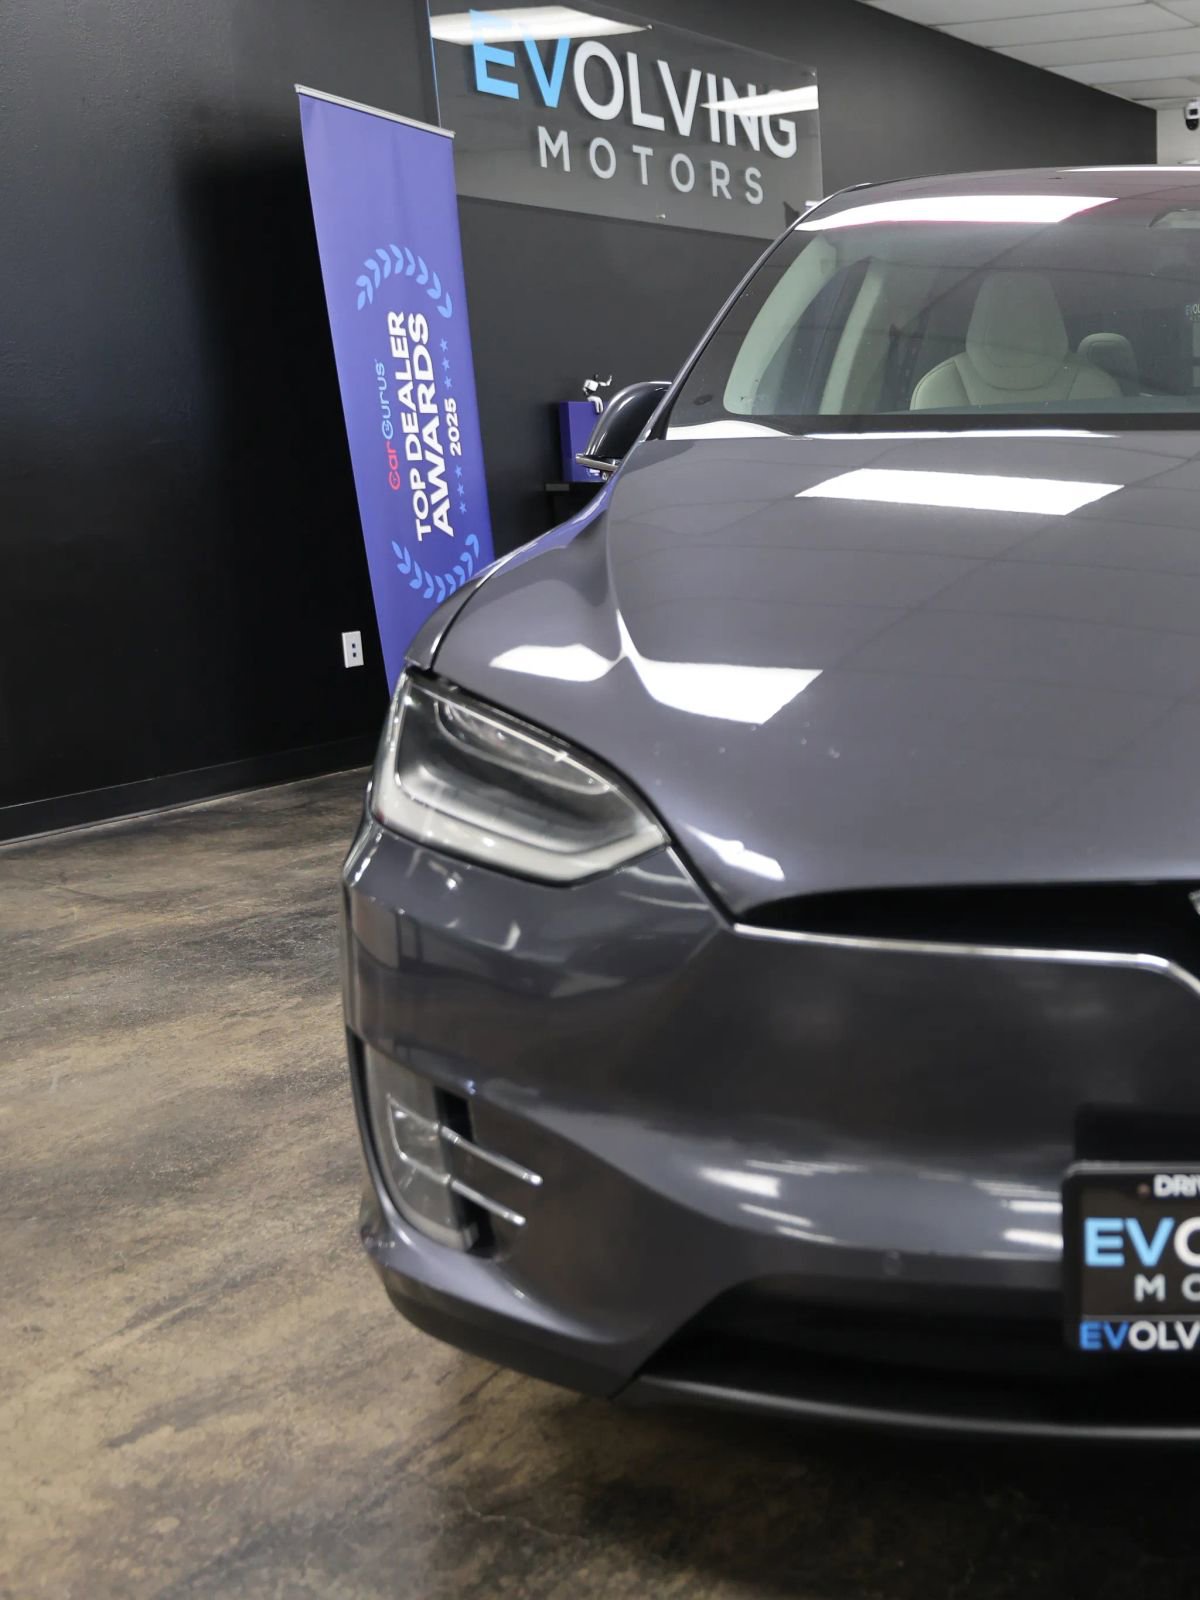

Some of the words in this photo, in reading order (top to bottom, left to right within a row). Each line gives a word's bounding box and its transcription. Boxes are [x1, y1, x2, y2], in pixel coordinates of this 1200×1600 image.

[469, 9, 797, 159] EVOLVING
[538, 125, 764, 205] MOTORS
[375, 360, 400, 490] CarGurus
[387, 311, 423, 461] DEALER
[408, 312, 454, 537] AWARDS
[444, 397, 462, 457] 2025
[410, 467, 432, 542] TOP
